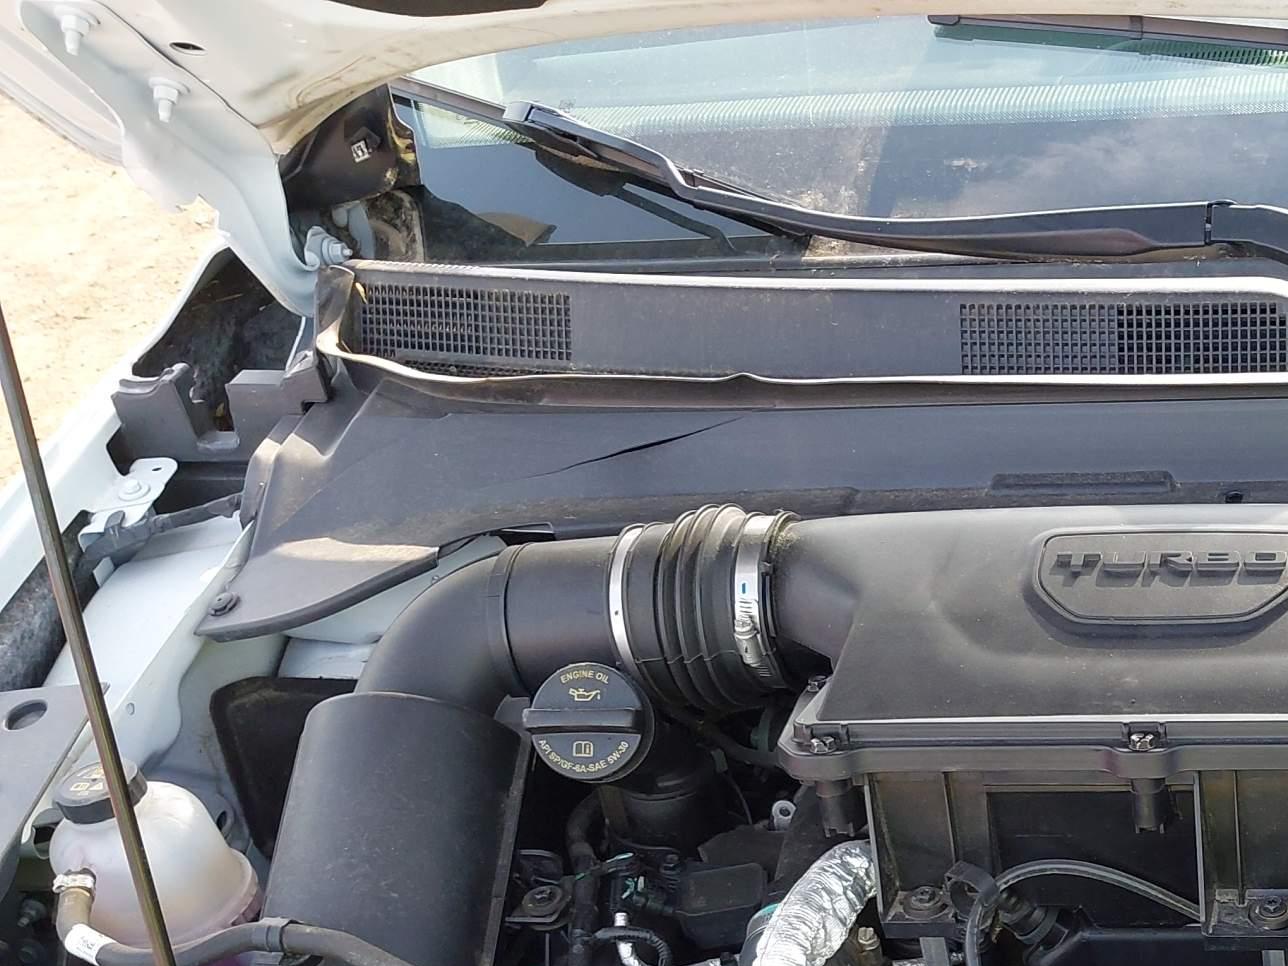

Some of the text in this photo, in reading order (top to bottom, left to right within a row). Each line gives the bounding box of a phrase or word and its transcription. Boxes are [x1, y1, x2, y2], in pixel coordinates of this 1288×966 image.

[1056, 551, 1288, 573] TURBO
[560, 670, 610, 684] ENGINE OIL
[538, 739, 553, 754] API
[607, 740, 629, 764] 5W-30
